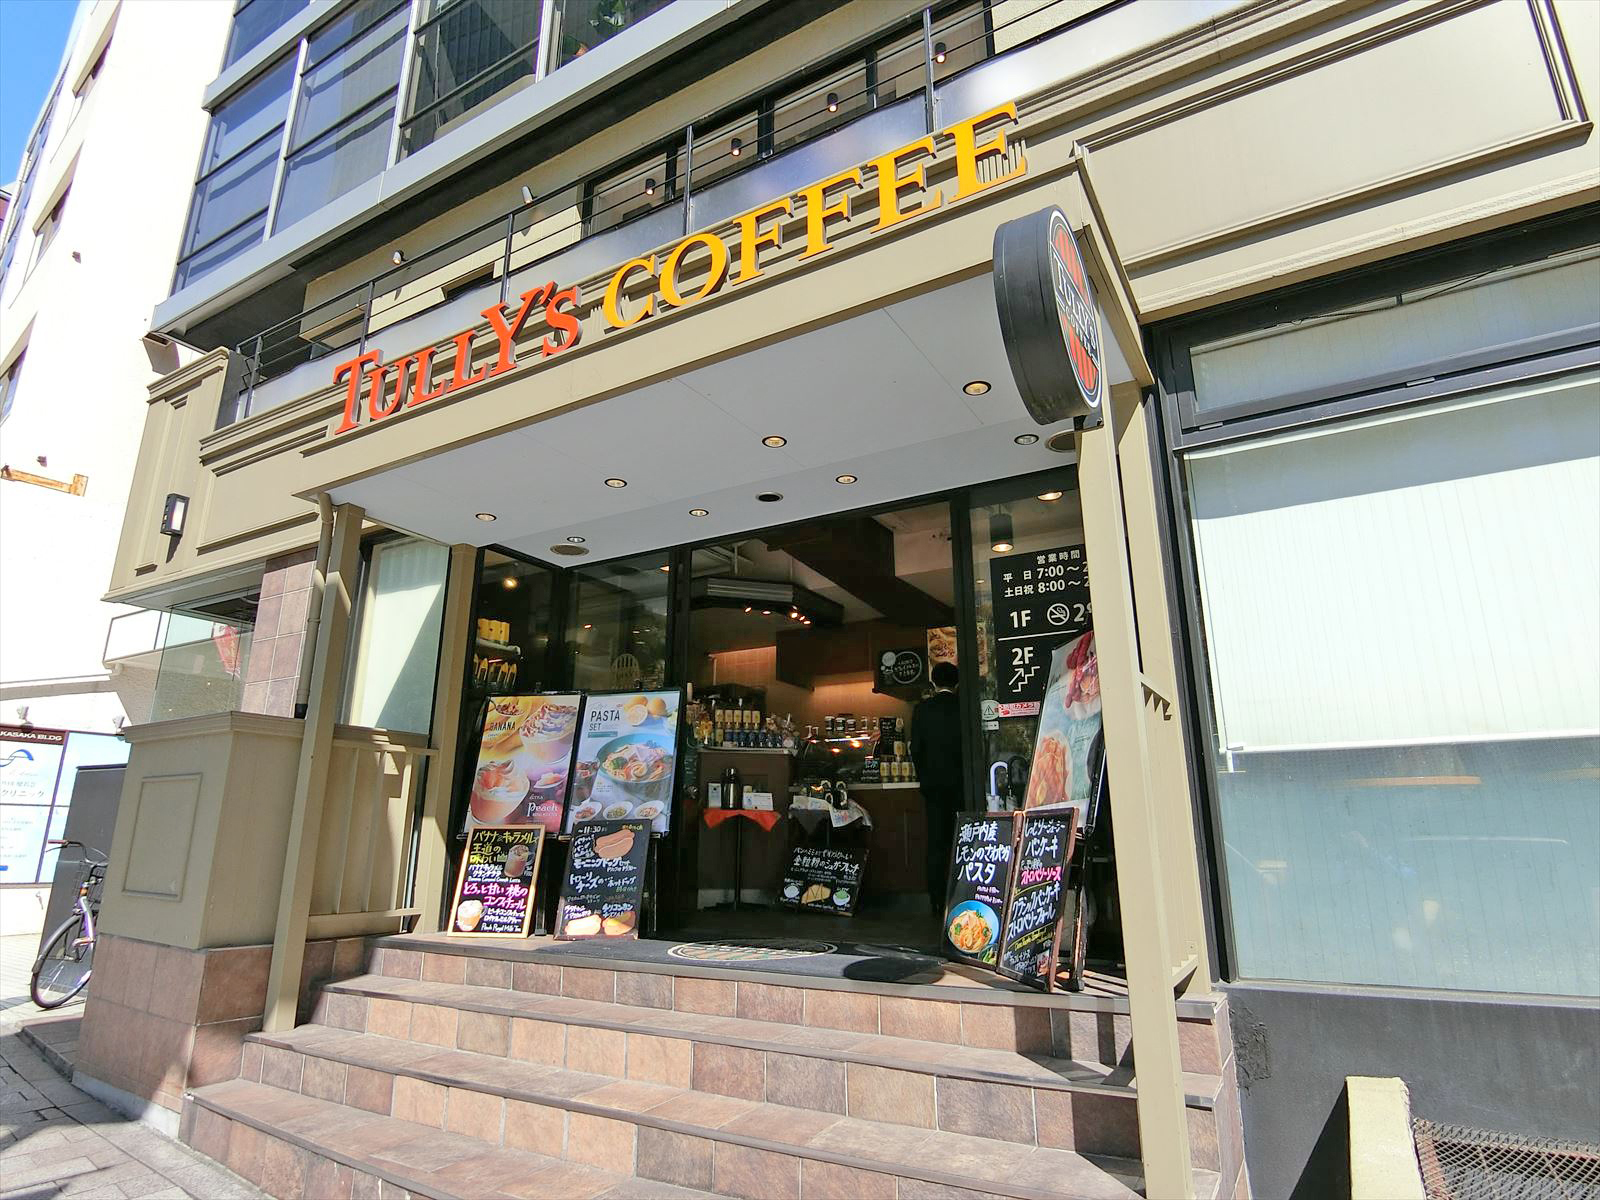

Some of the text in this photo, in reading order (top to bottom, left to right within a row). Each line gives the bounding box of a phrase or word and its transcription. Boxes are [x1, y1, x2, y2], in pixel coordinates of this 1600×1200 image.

[333, 101, 1027, 435] TULLY'S COFFEE
[1036, 549, 1080, 565] 営業時間
[1004, 584, 1034, 597] 土日祝
[1010, 609, 1031, 628] 1F
[1011, 646, 1034, 666] 2F
[590, 709, 620, 722] PASTA
[489, 721, 516, 731] BANANA
[589, 723, 602, 731] SET
[0, 730, 36, 739] KASAKA
[2, 789, 45, 797] クリニック
[526, 802, 558, 817] Peach
[958, 820, 999, 844] 瀬戸内産
[471, 844, 501, 856] 王道の
[956, 844, 1011, 864] レモンのさわやか
[1025, 835, 1058, 858] パンケーキ
[470, 855, 497, 864] 味わい
[957, 862, 996, 885] パスタ
[1021, 866, 1062, 886] ストロベリーソース
[1013, 881, 1061, 921] クラシックパンケーキ
